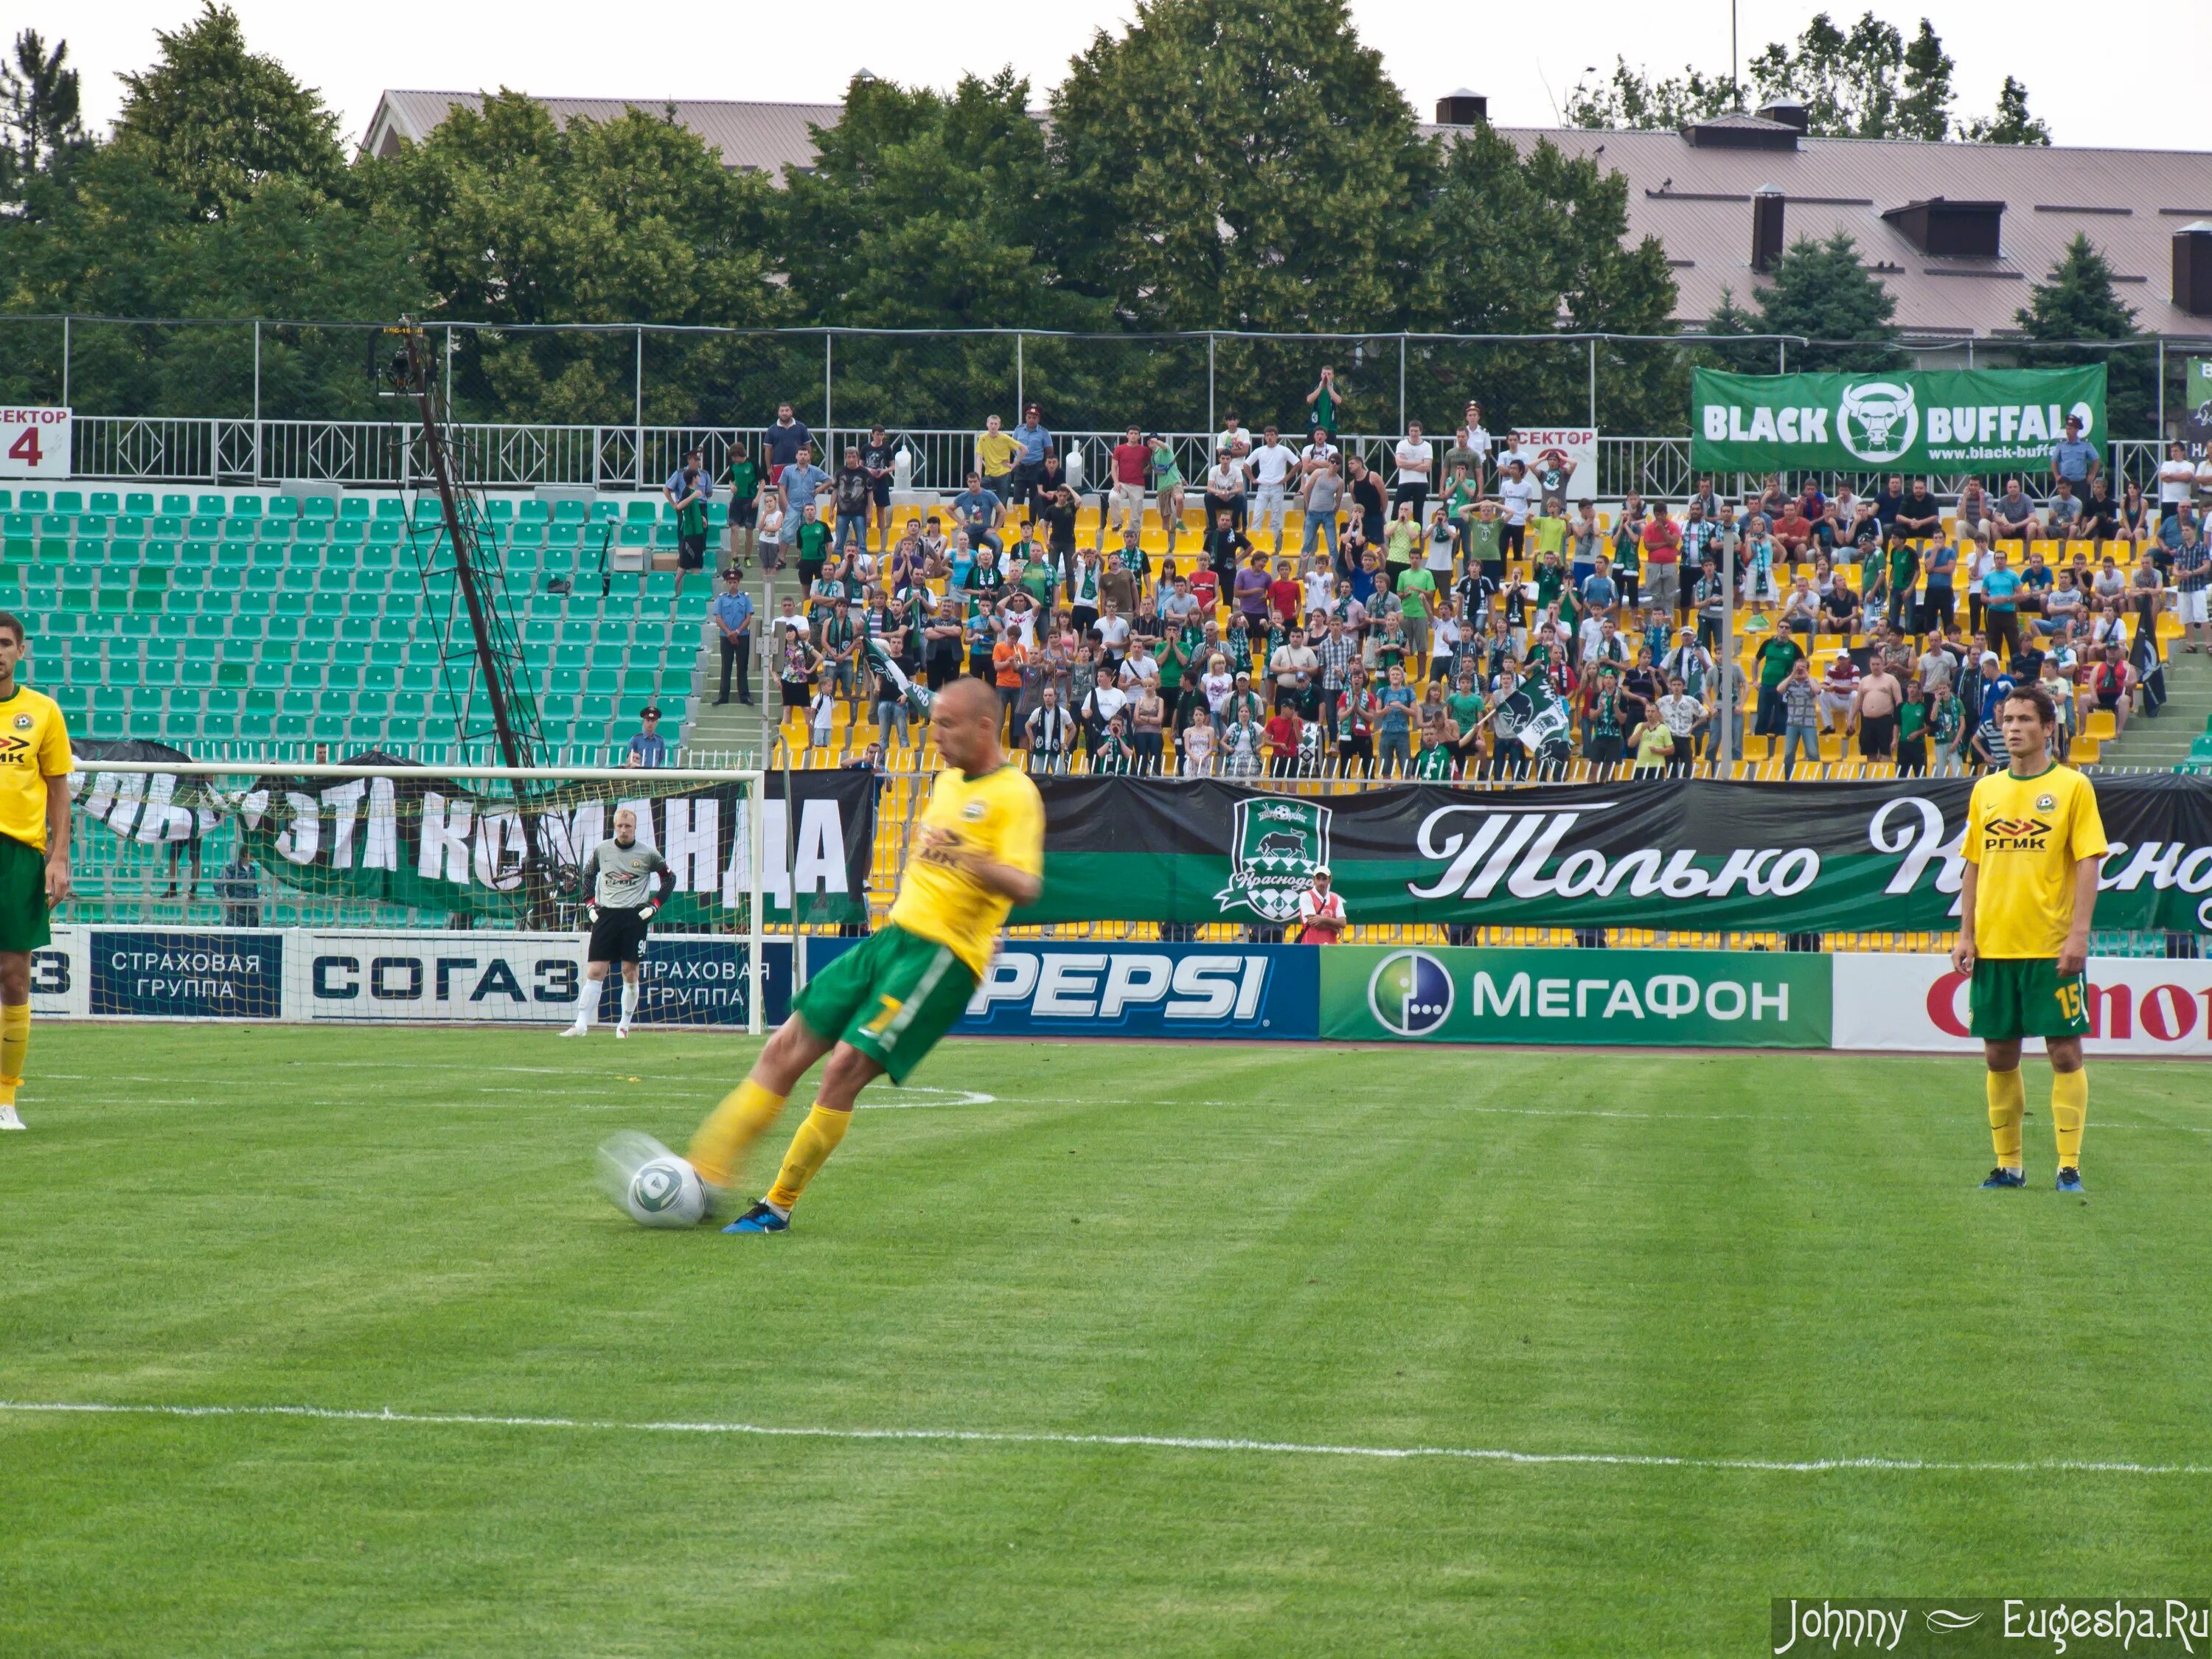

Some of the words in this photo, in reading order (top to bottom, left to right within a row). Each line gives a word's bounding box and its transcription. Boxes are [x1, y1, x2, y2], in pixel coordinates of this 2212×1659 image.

[0, 410, 67, 423] ЕКТОР
[1703, 405, 1828, 442] BLACK
[1927, 403, 2093, 443] BUFFALO
[9, 426, 43, 467] 4
[1518, 431, 1593, 445] СЕКТОР
[1928, 445, 2056, 460] www.black-buffa
[1408, 801, 1820, 900] Только
[1986, 838, 2046, 849] РГМК
[112, 952, 260, 973] СТРАХОВАЯ
[639, 961, 770, 980] ТРАХОВАЯ
[138, 978, 234, 998] ГРУППА
[312, 956, 579, 1003] СОГАЗ
[964, 952, 1268, 1020] PEPSI
[647, 987, 745, 1006] ГРУППА
[1474, 971, 1789, 1021] МЕГАФОН
[2054, 982, 2081, 1020] 15
